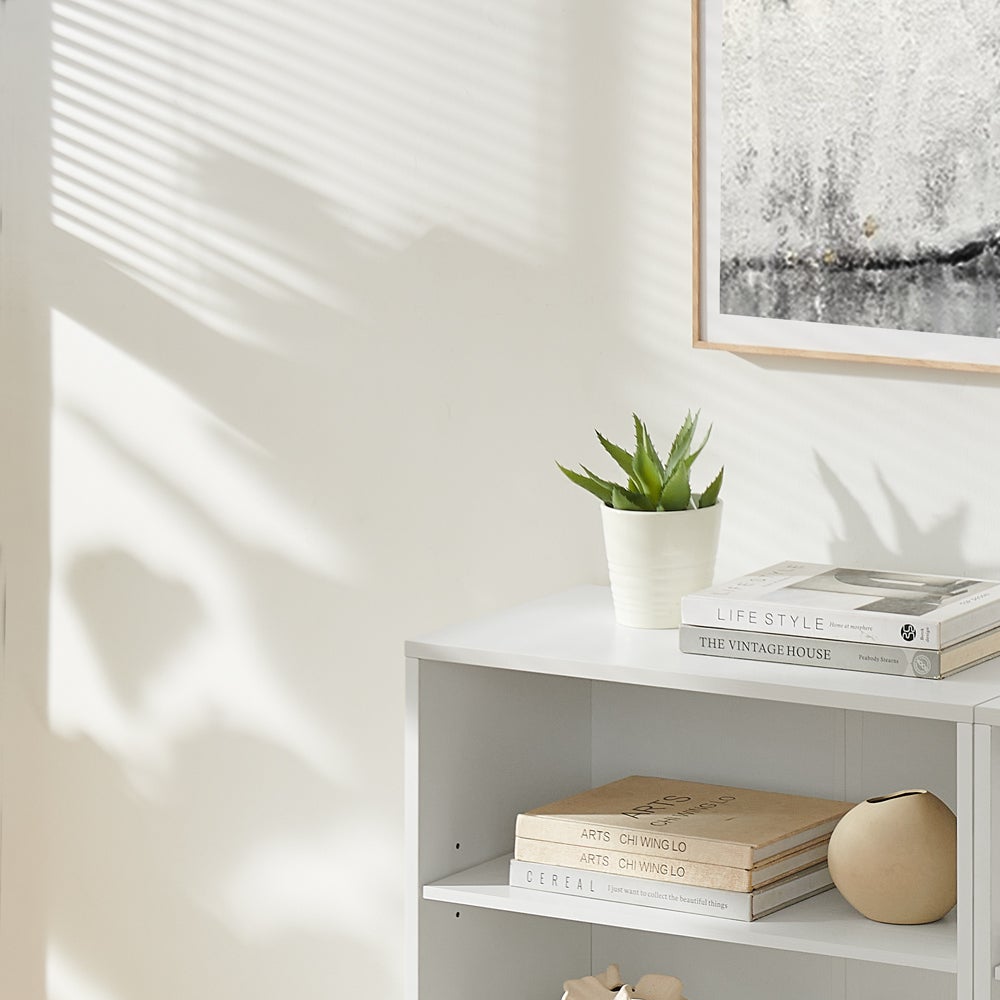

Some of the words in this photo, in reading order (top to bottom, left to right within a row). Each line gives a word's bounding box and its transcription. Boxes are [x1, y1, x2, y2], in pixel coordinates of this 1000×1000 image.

[699, 636, 725, 649] THE
[729, 639, 784, 655] VINTAGE
[787, 645, 831, 660] HOUSE
[858, 654, 880, 663] Peabody
[622, 795, 692, 819] ARTS
[581, 829, 611, 842] ARTS
[619, 834, 638, 846] CHI
[640, 836, 670, 851] WING
[672, 840, 687, 853] LO
[580, 853, 610, 867] ARTS
[618, 857, 637, 870] CHI
[639, 860, 669, 875] WING
[670, 865, 686, 878] LO
[526, 870, 595, 892] CEREAL
[610, 885, 623, 894] just
[624, 888, 639, 897] want
[640, 889, 647, 897] to
[647, 890, 668, 900] collect
[668, 893, 679, 901] the
[679, 894, 708, 906] beautiful
[708, 899, 729, 910] things
